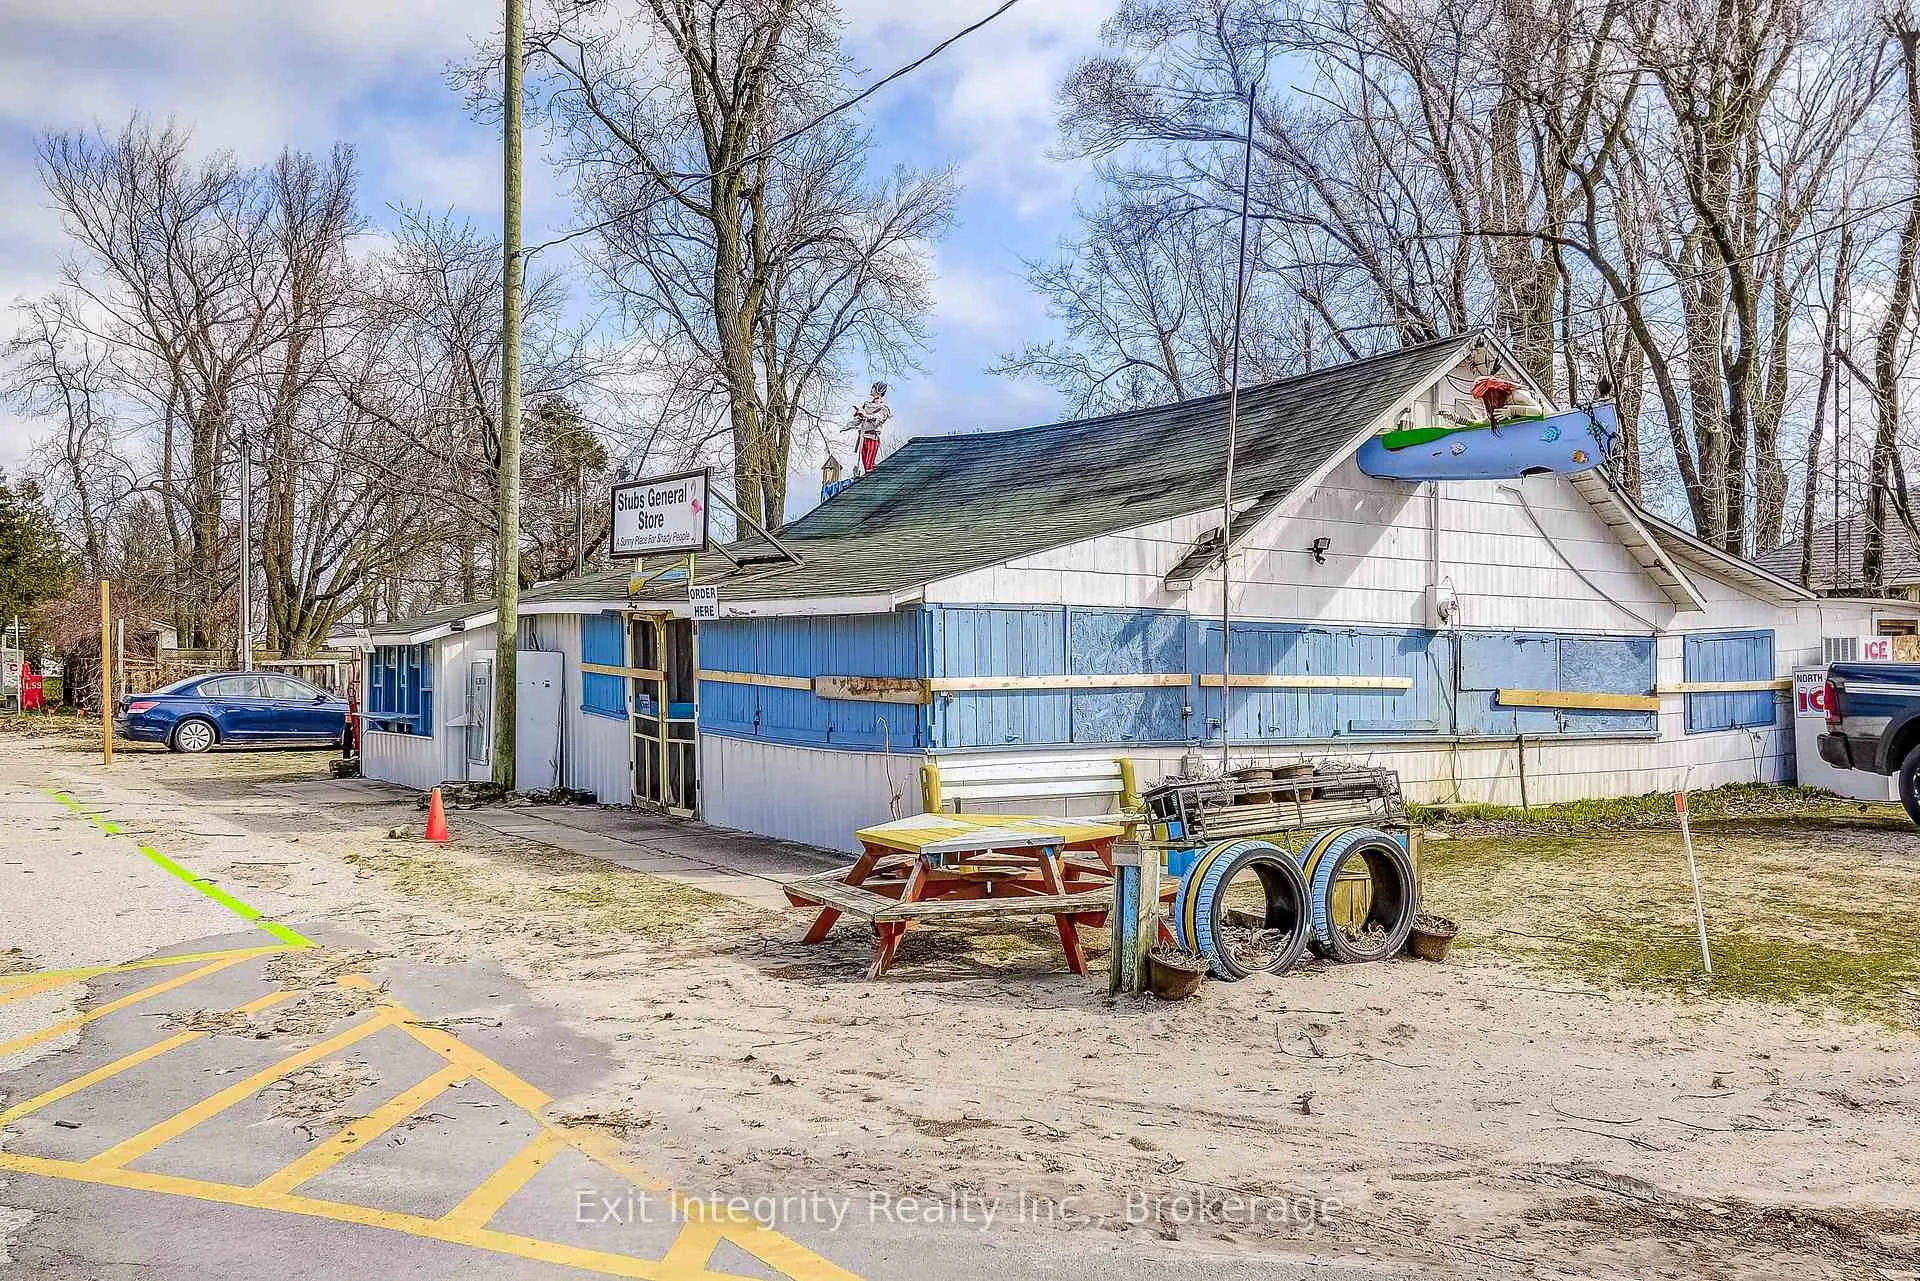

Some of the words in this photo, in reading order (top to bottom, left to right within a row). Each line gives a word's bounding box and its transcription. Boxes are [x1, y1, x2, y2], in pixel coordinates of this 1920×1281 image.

[617, 491, 645, 512] Stubs
[647, 482, 687, 508] General
[638, 510, 664, 530] Store
[648, 533, 656, 544] For
[672, 531, 690, 544] People
[689, 587, 716, 599] ORDER
[694, 605, 715, 617] HERE
[1864, 640, 1888, 660] ICE
[1796, 673, 1823, 683] NORTH
[1798, 686, 1825, 712] IC
